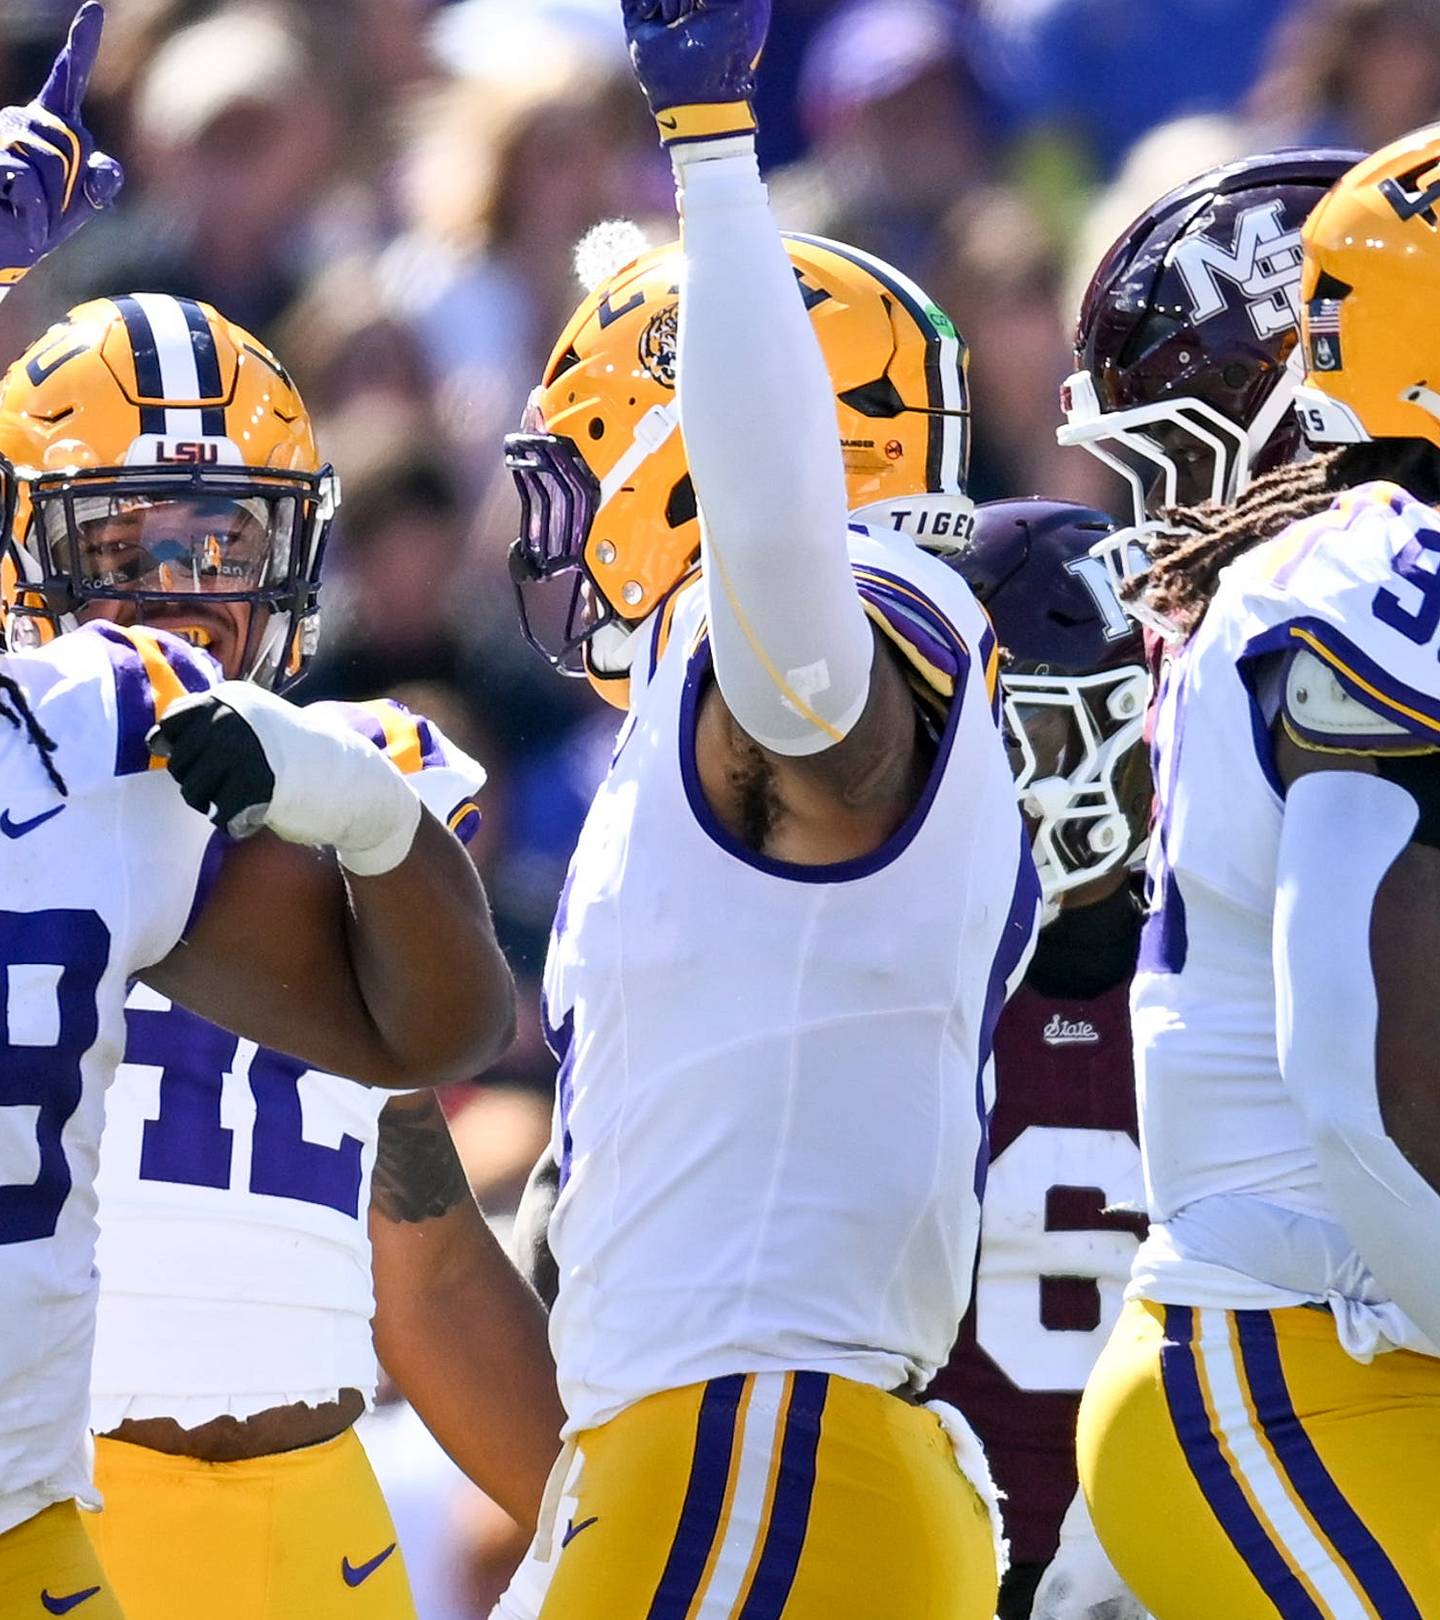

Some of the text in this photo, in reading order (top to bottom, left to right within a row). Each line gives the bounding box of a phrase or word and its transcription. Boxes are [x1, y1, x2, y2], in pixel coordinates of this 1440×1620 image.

[1168, 199, 1303, 341] MS
[156, 441, 218, 463] LSU
[1043, 1014, 1100, 1045] State
[975, 1125, 1150, 1392] 6
